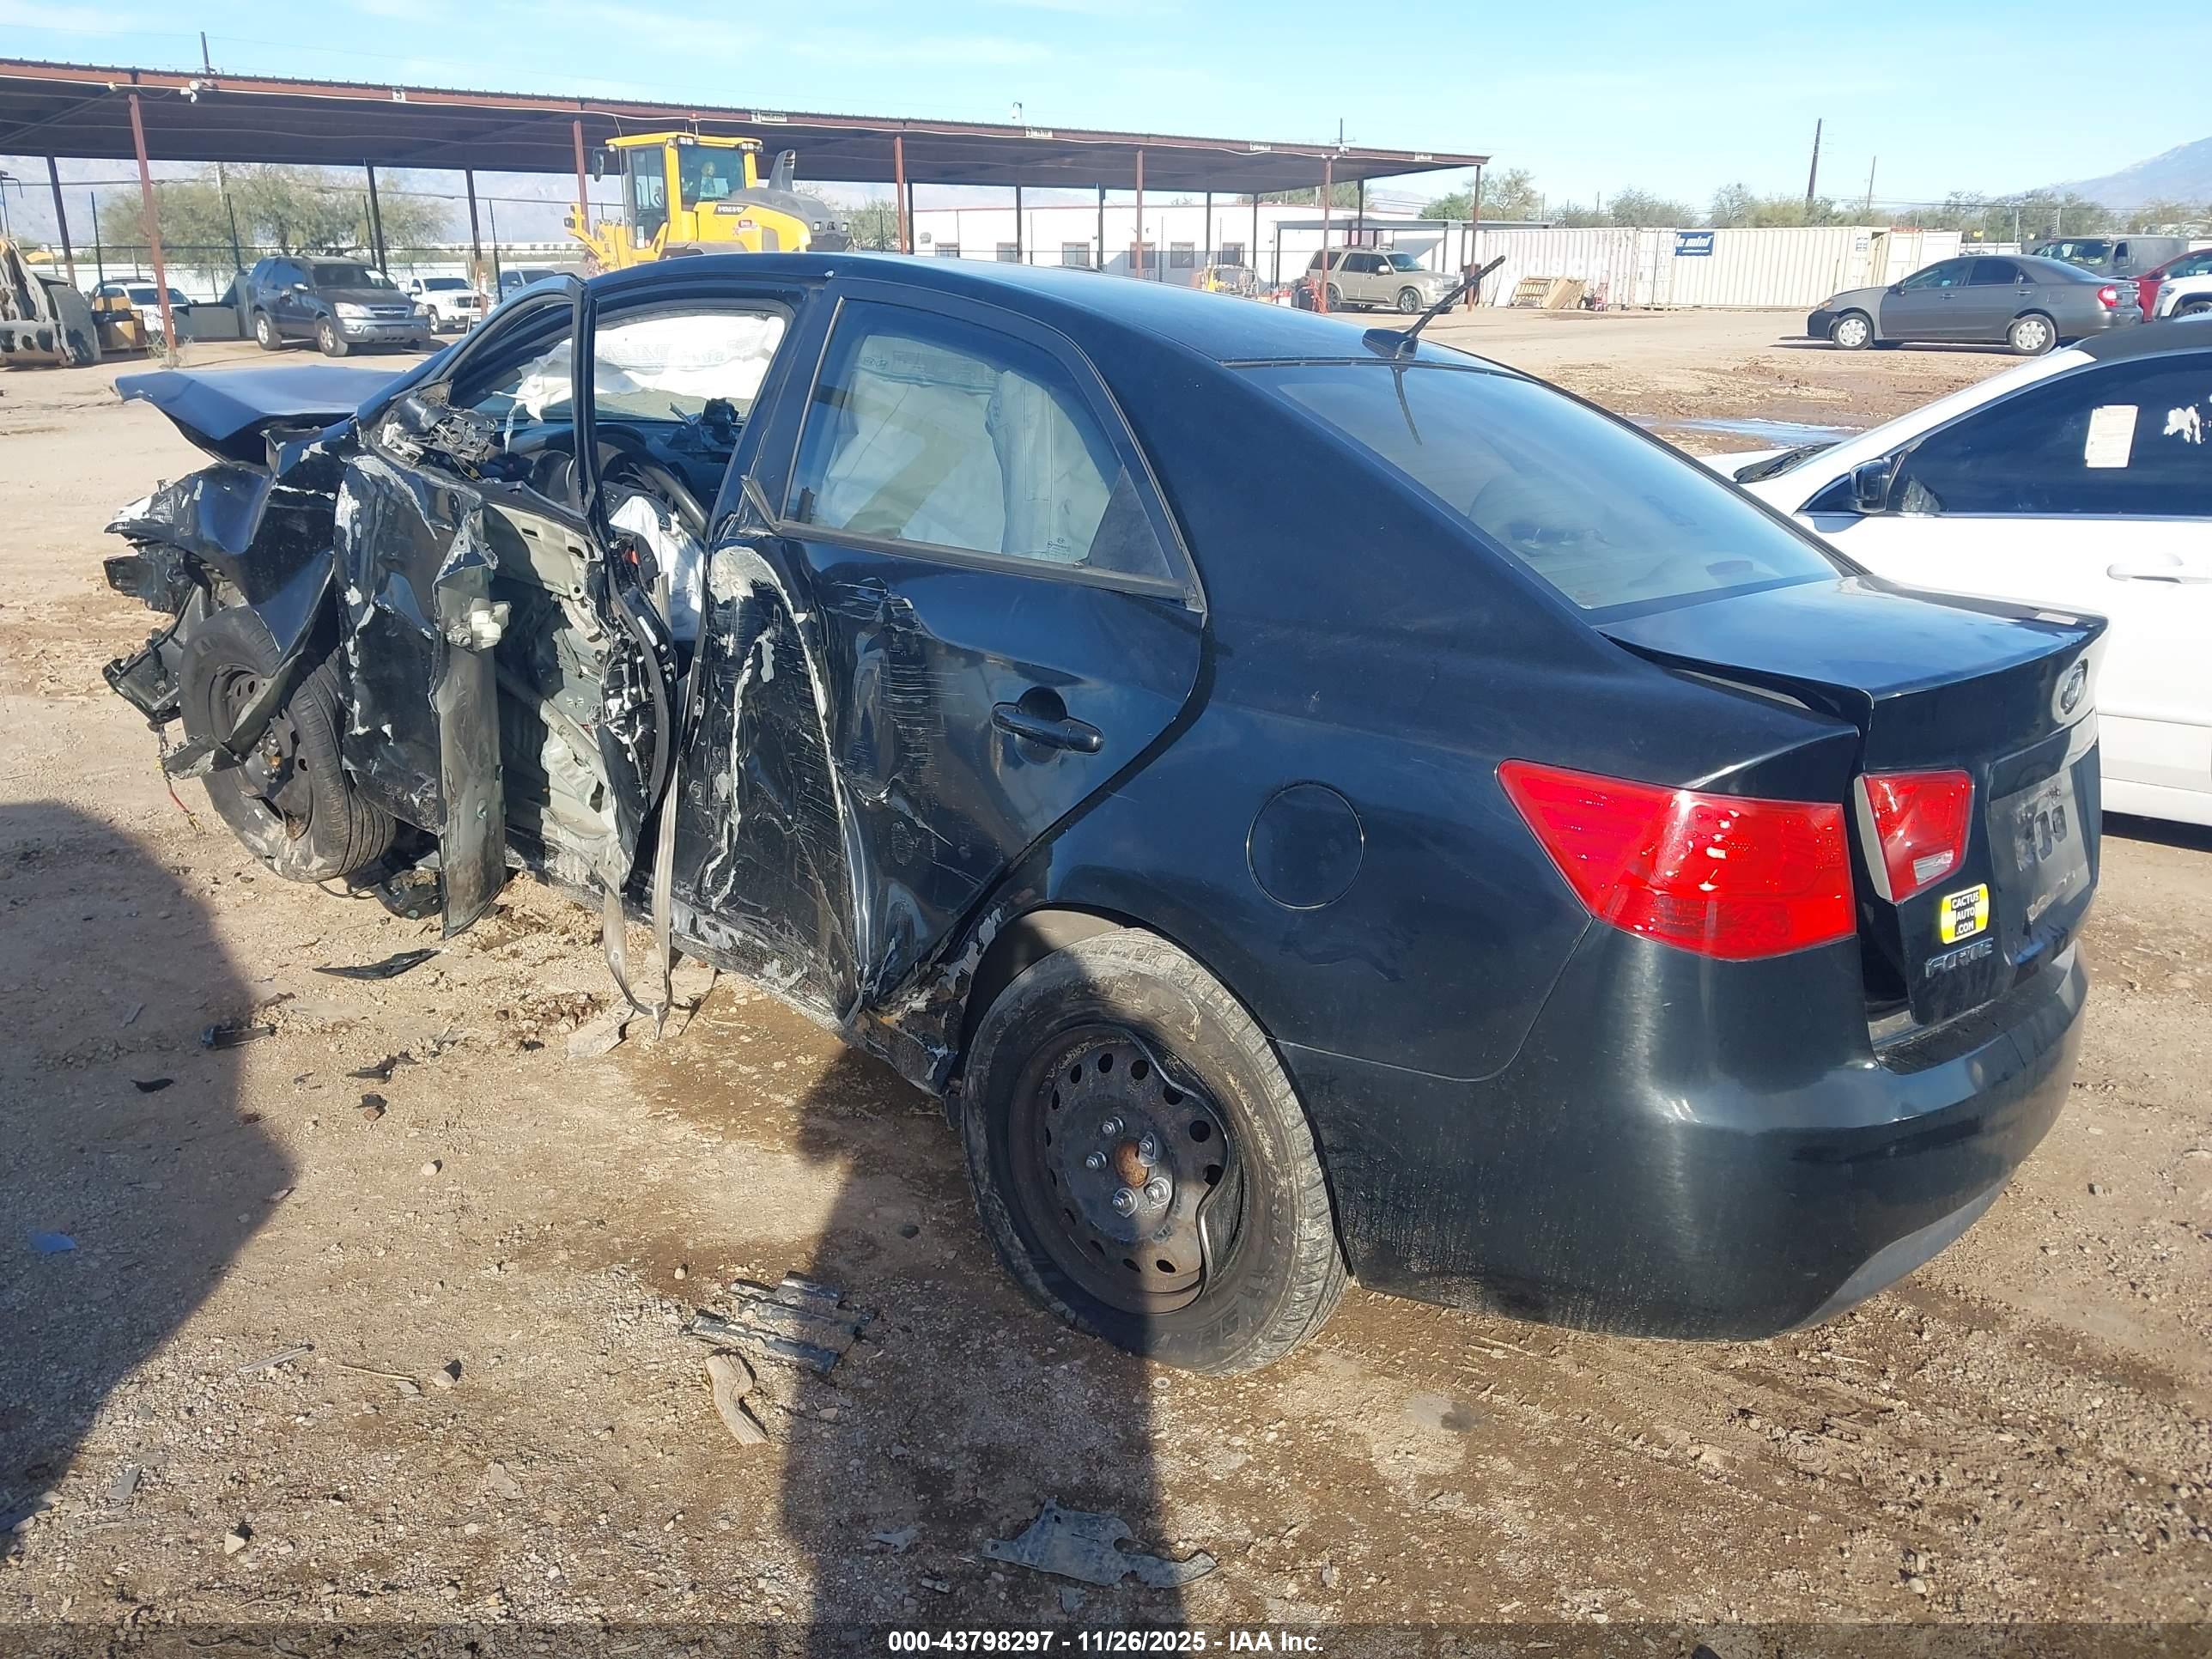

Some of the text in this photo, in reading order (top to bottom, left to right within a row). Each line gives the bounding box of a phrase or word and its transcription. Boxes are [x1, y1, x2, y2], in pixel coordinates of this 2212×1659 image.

[396, 88, 402, 100] 5
[1951, 890, 1980, 910] CACTUS
[1956, 906, 1976, 922] AUTO
[1955, 920, 1975, 936] .COM
